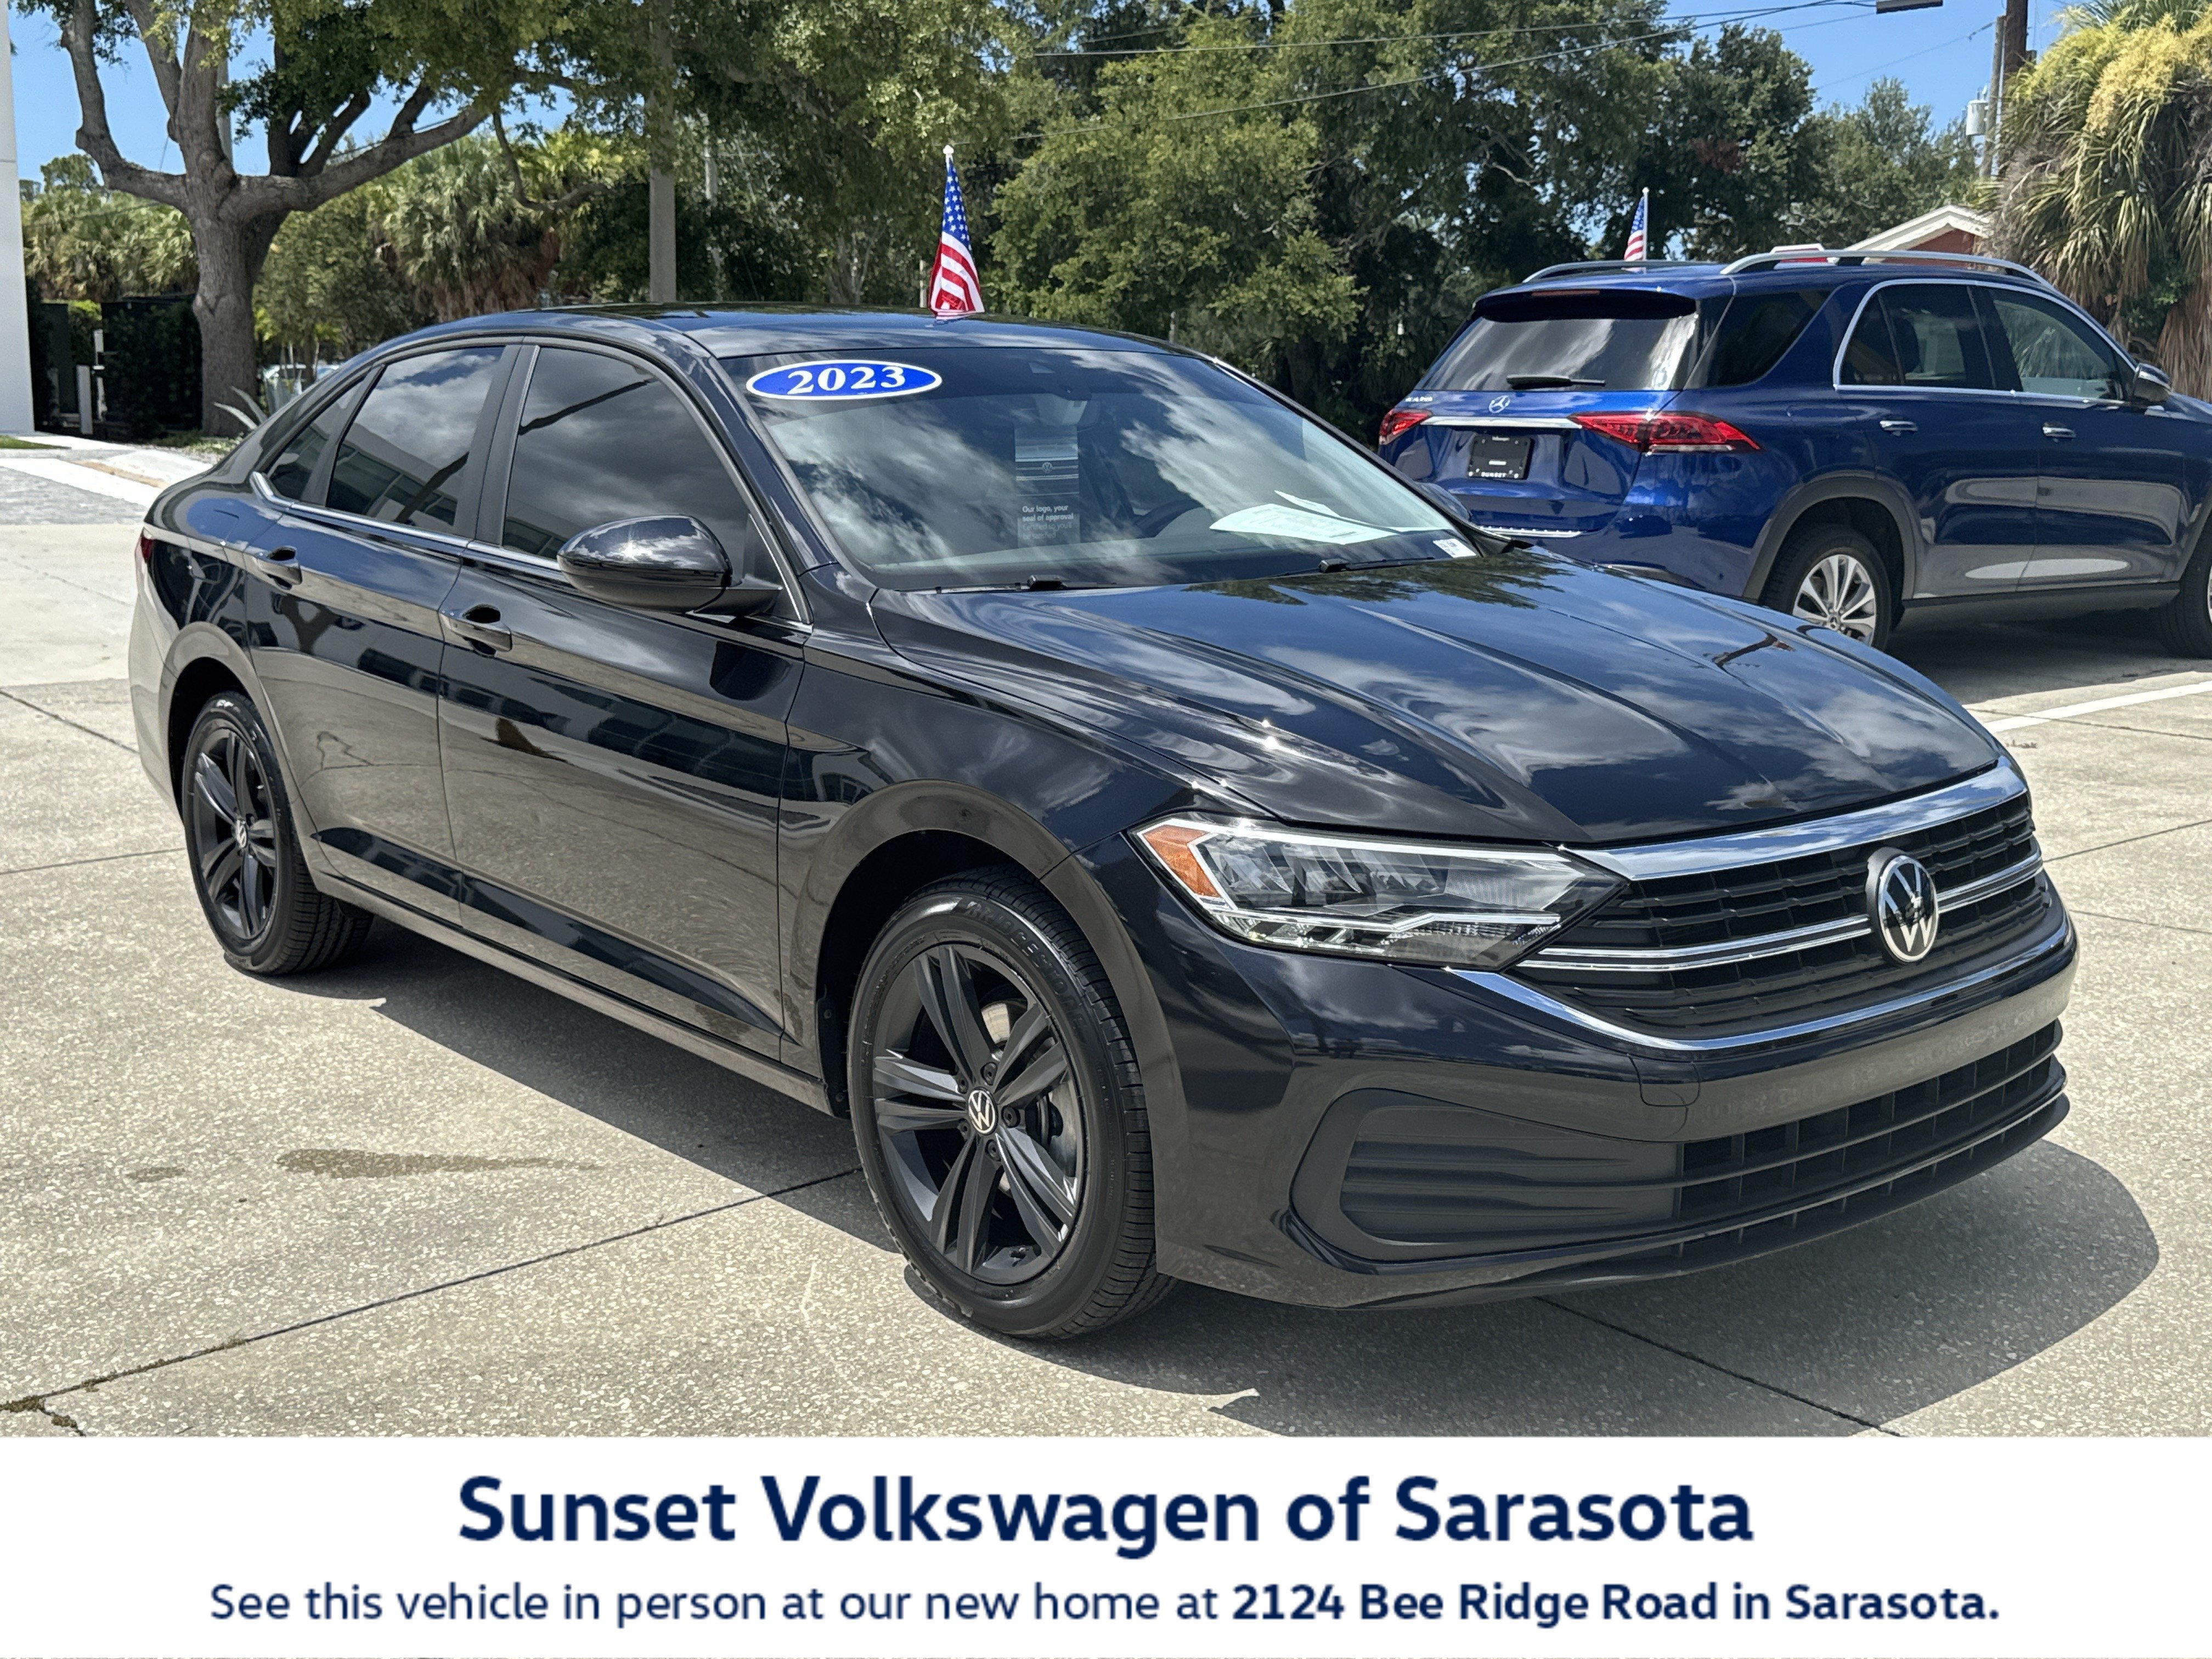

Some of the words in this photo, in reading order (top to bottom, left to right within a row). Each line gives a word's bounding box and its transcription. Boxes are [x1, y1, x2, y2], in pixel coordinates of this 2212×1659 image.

[787, 366, 906, 395] 2023
[1053, 505, 1069, 513] your
[1037, 513, 1044, 521] of
